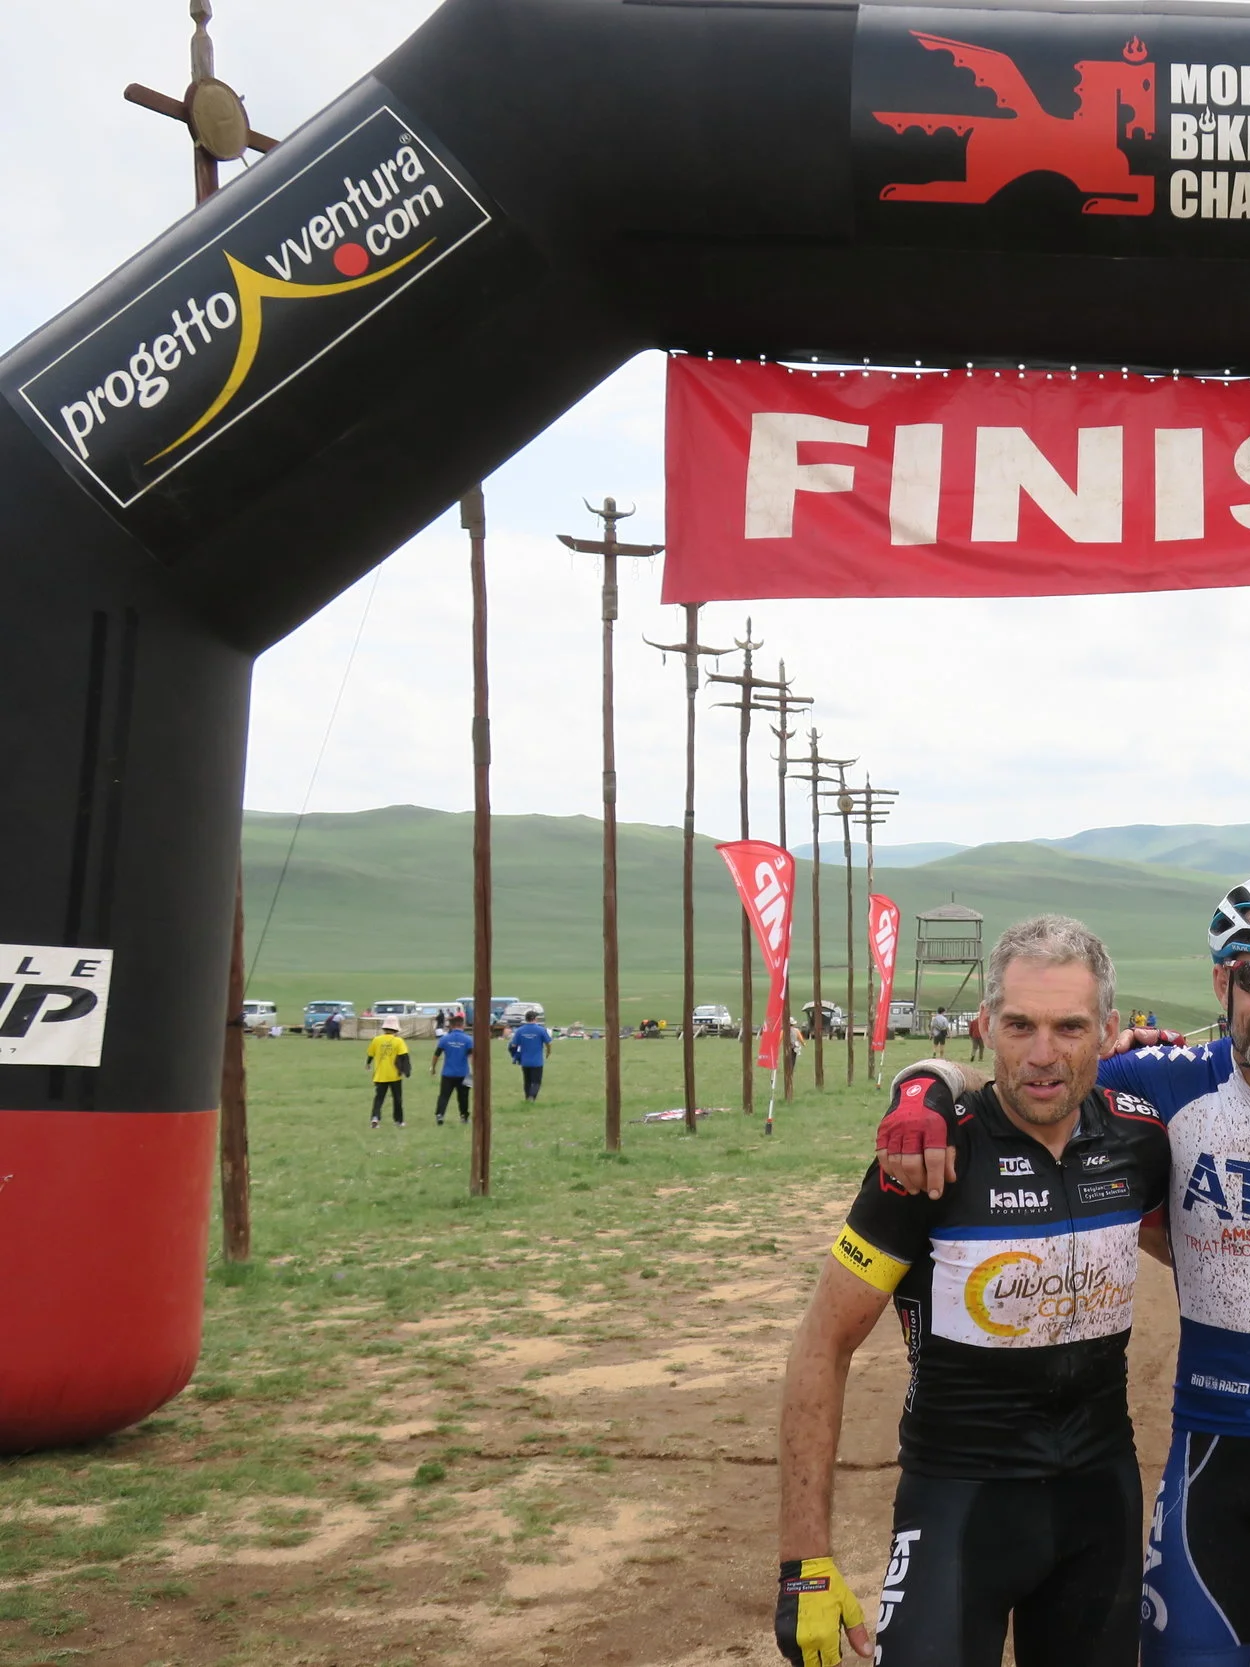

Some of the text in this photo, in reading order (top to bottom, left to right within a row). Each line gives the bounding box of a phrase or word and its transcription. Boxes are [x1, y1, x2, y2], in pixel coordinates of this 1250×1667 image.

[60, 291, 237, 459] progetto
[989, 1188, 1050, 1208] kalas
[1084, 1188, 1127, 1200] Cycling Selection
[990, 1207, 1054, 1216] SPORTSWEAR
[839, 1235, 873, 1268] kalas
